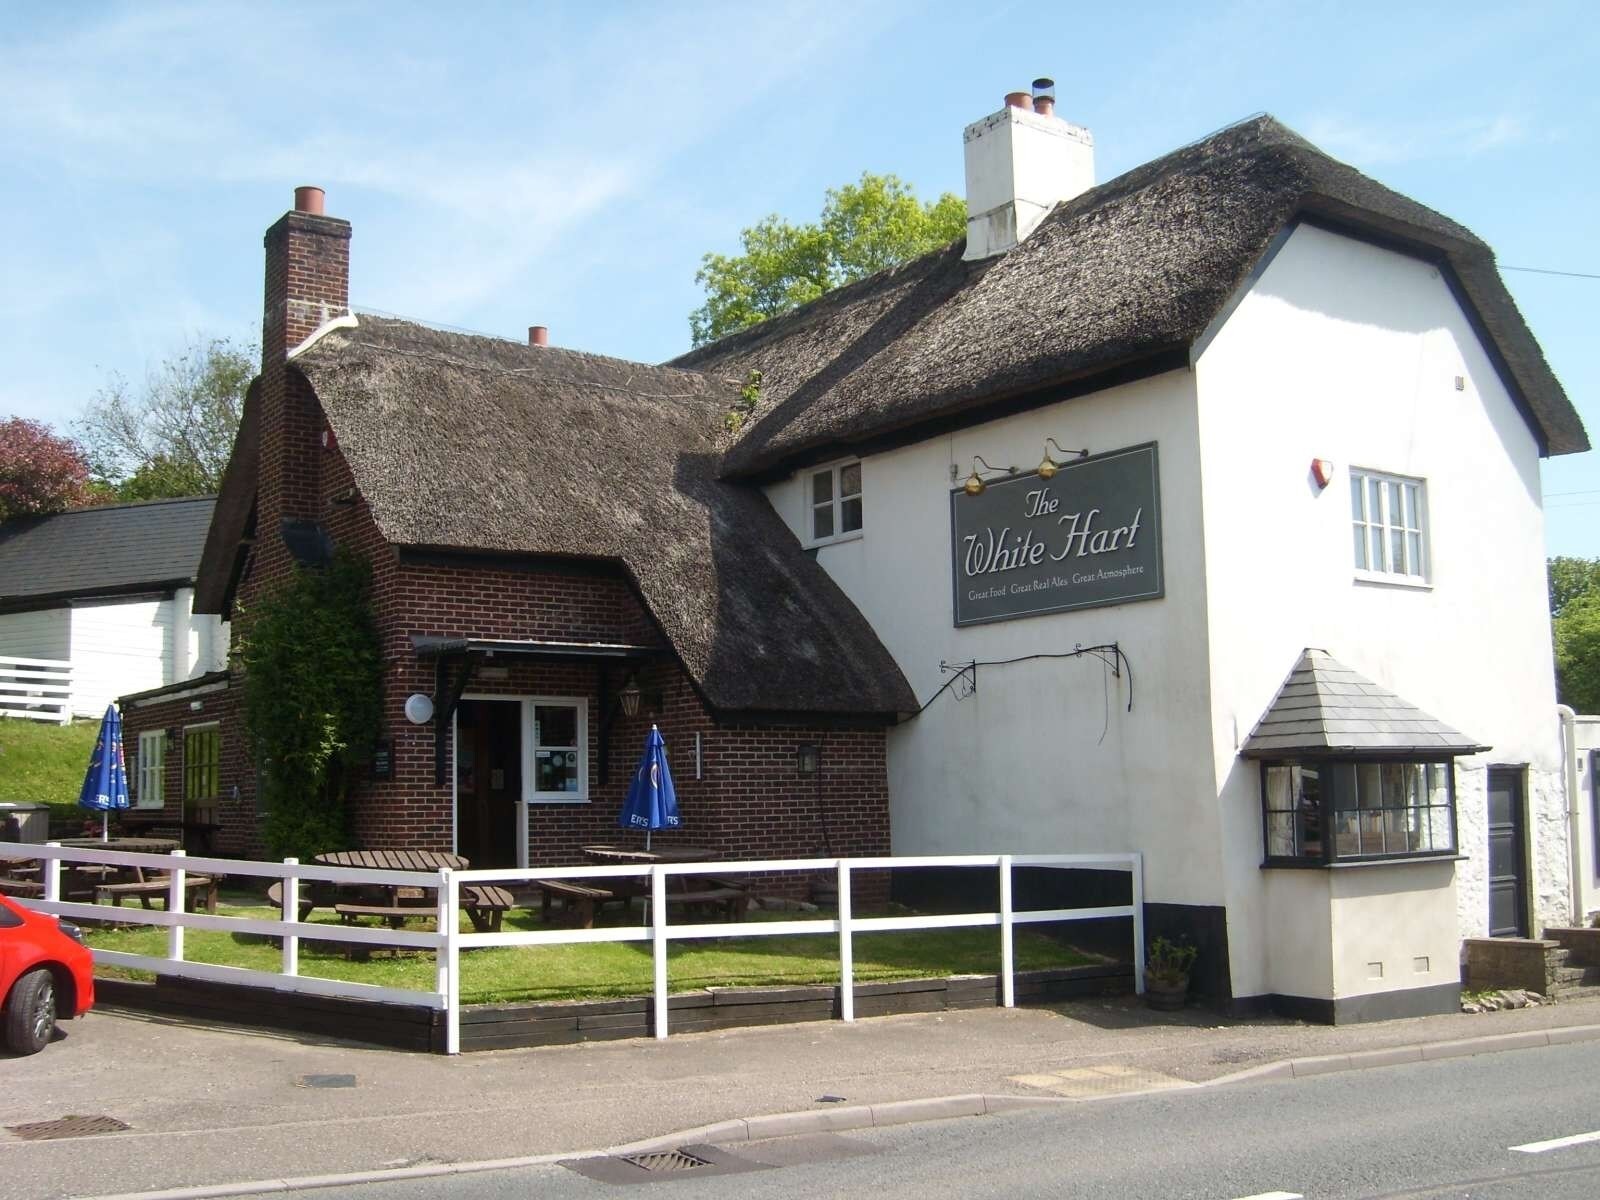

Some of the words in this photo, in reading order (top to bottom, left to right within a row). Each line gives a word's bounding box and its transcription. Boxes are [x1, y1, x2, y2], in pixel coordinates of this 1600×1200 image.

[1024, 487, 1059, 518] The
[963, 527, 1045, 576] White
[1050, 507, 1142, 561] Hart
[968, 589, 988, 601] Great
[989, 584, 1006, 598] Food
[1010, 583, 1032, 594] Great
[1033, 578, 1050, 591] Real
[1051, 576, 1068, 588] Ales
[1072, 572, 1095, 584] Great
[1096, 564, 1144, 579] Atmosphere
